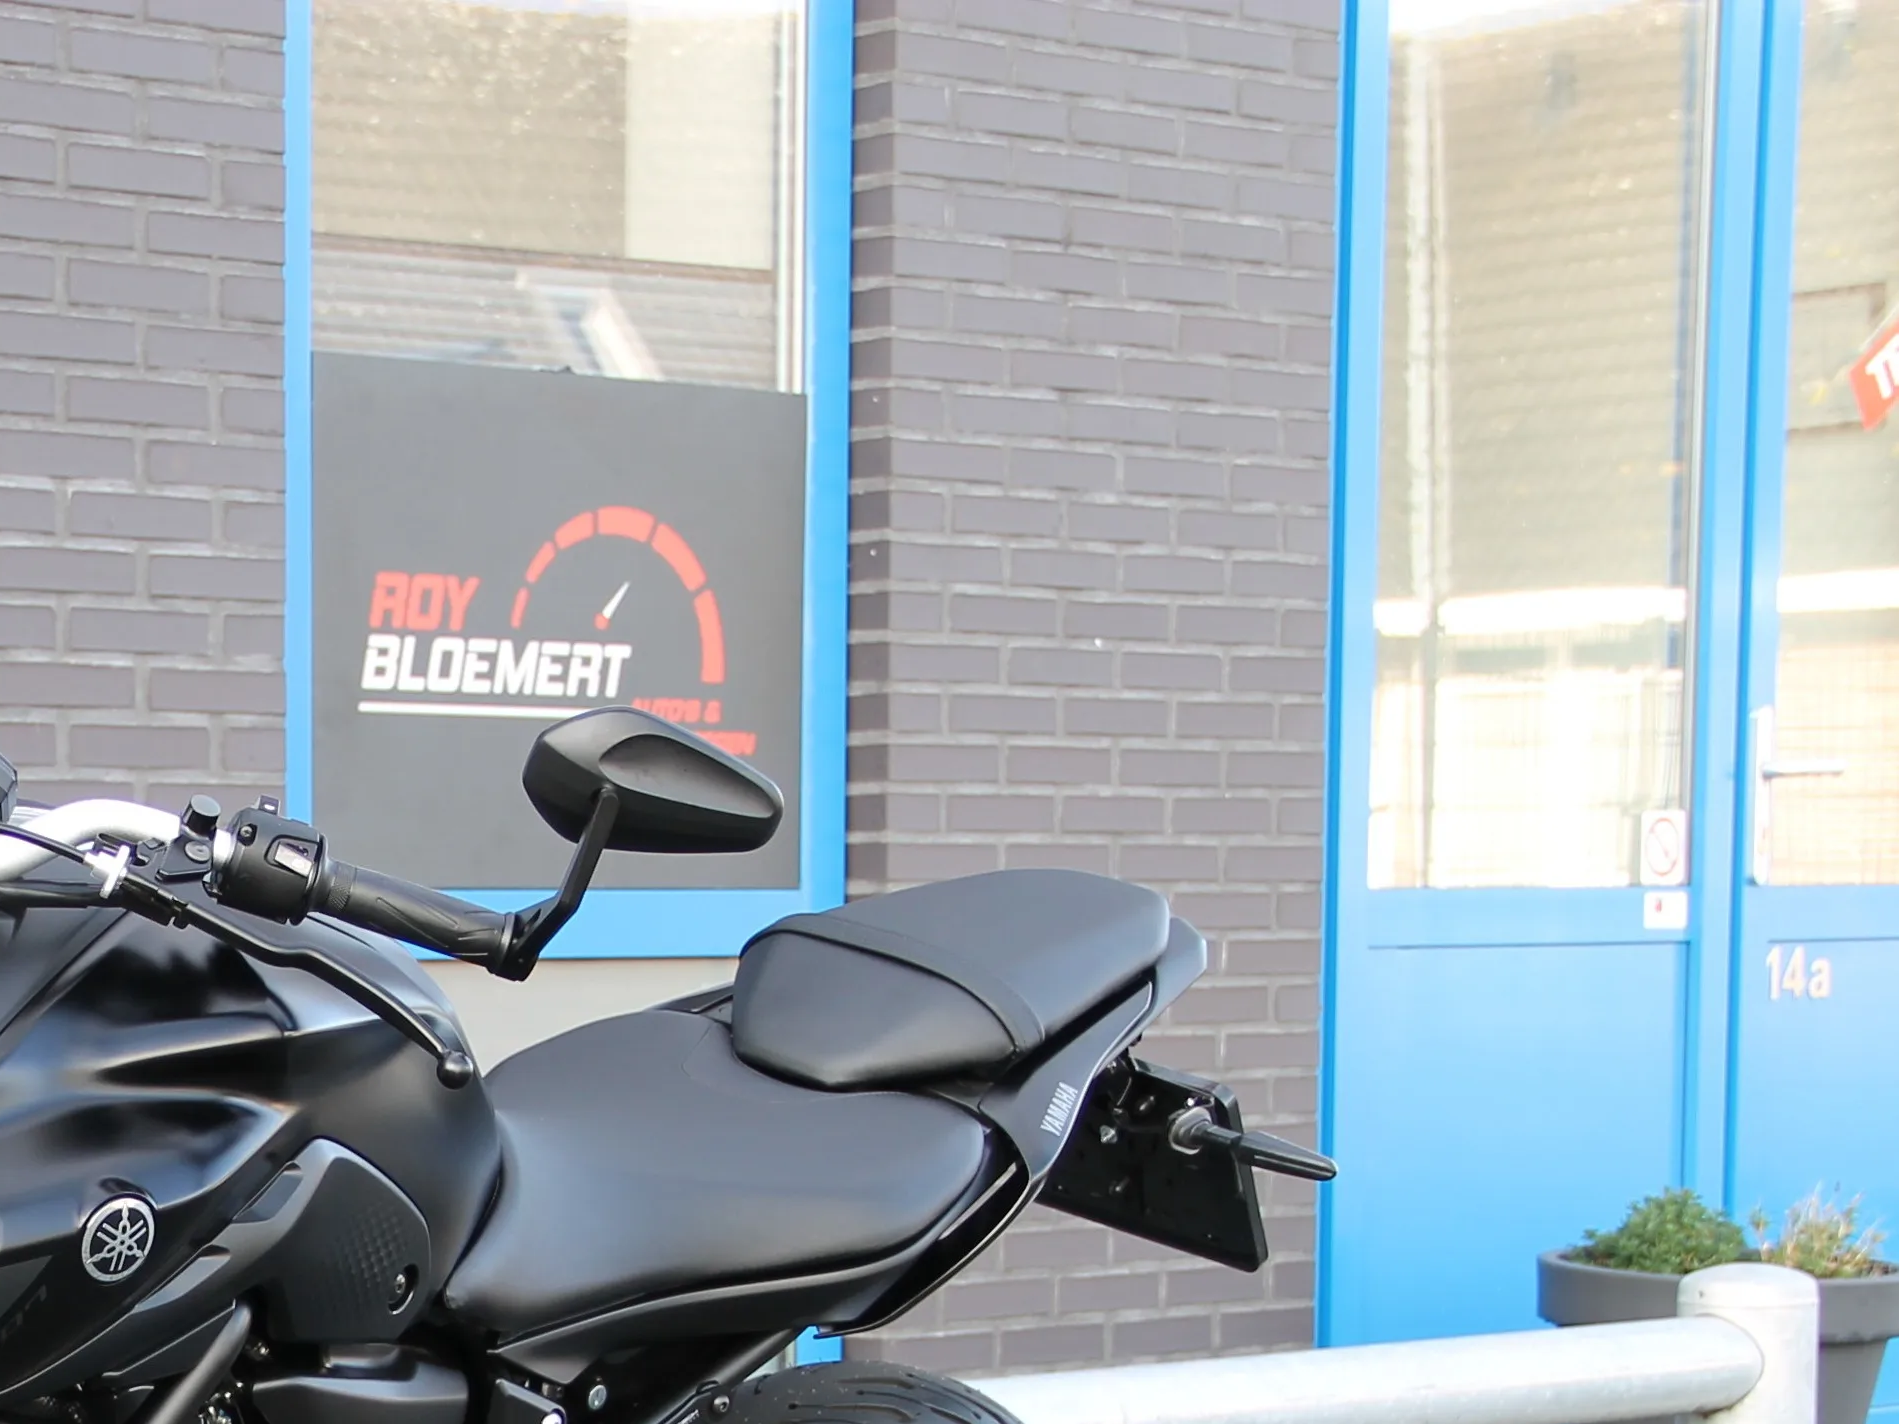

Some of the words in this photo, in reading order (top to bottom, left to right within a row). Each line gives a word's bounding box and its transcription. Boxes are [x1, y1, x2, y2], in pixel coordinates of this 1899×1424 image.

[368, 571, 481, 632] ROY
[360, 633, 633, 698] BLOEMERT
[1765, 946, 1832, 1000] 14a
[1039, 1081, 1079, 1137] YAMAHA
